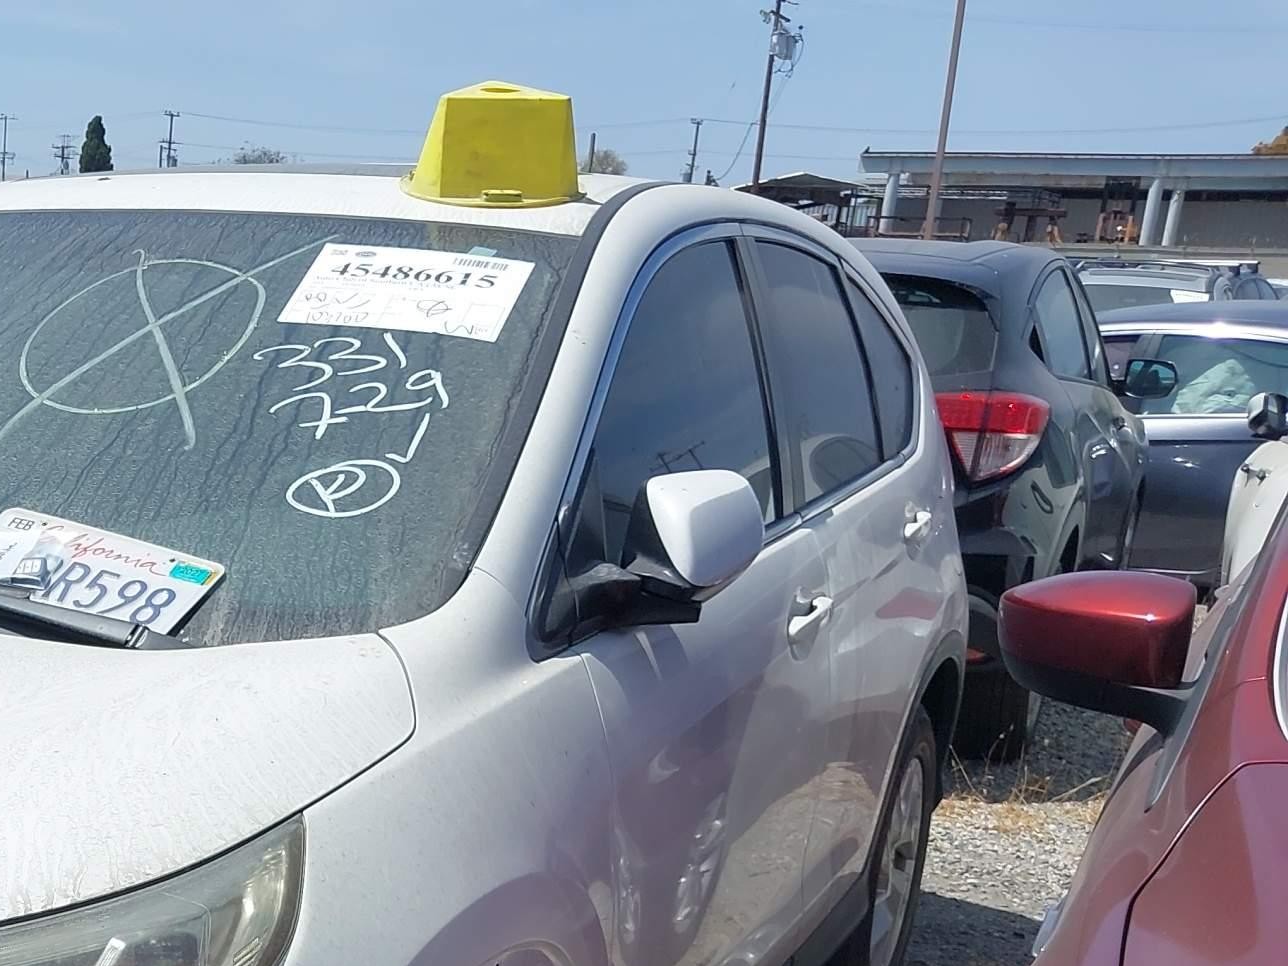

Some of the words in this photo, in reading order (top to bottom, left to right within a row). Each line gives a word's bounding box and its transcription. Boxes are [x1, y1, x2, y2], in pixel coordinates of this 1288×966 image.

[330, 261, 499, 289] 45486615
[268, 369, 450, 440] 729
[8, 517, 35, 531] FEB
[41, 524, 166, 577] Clifornia
[42, 561, 176, 625] R598
